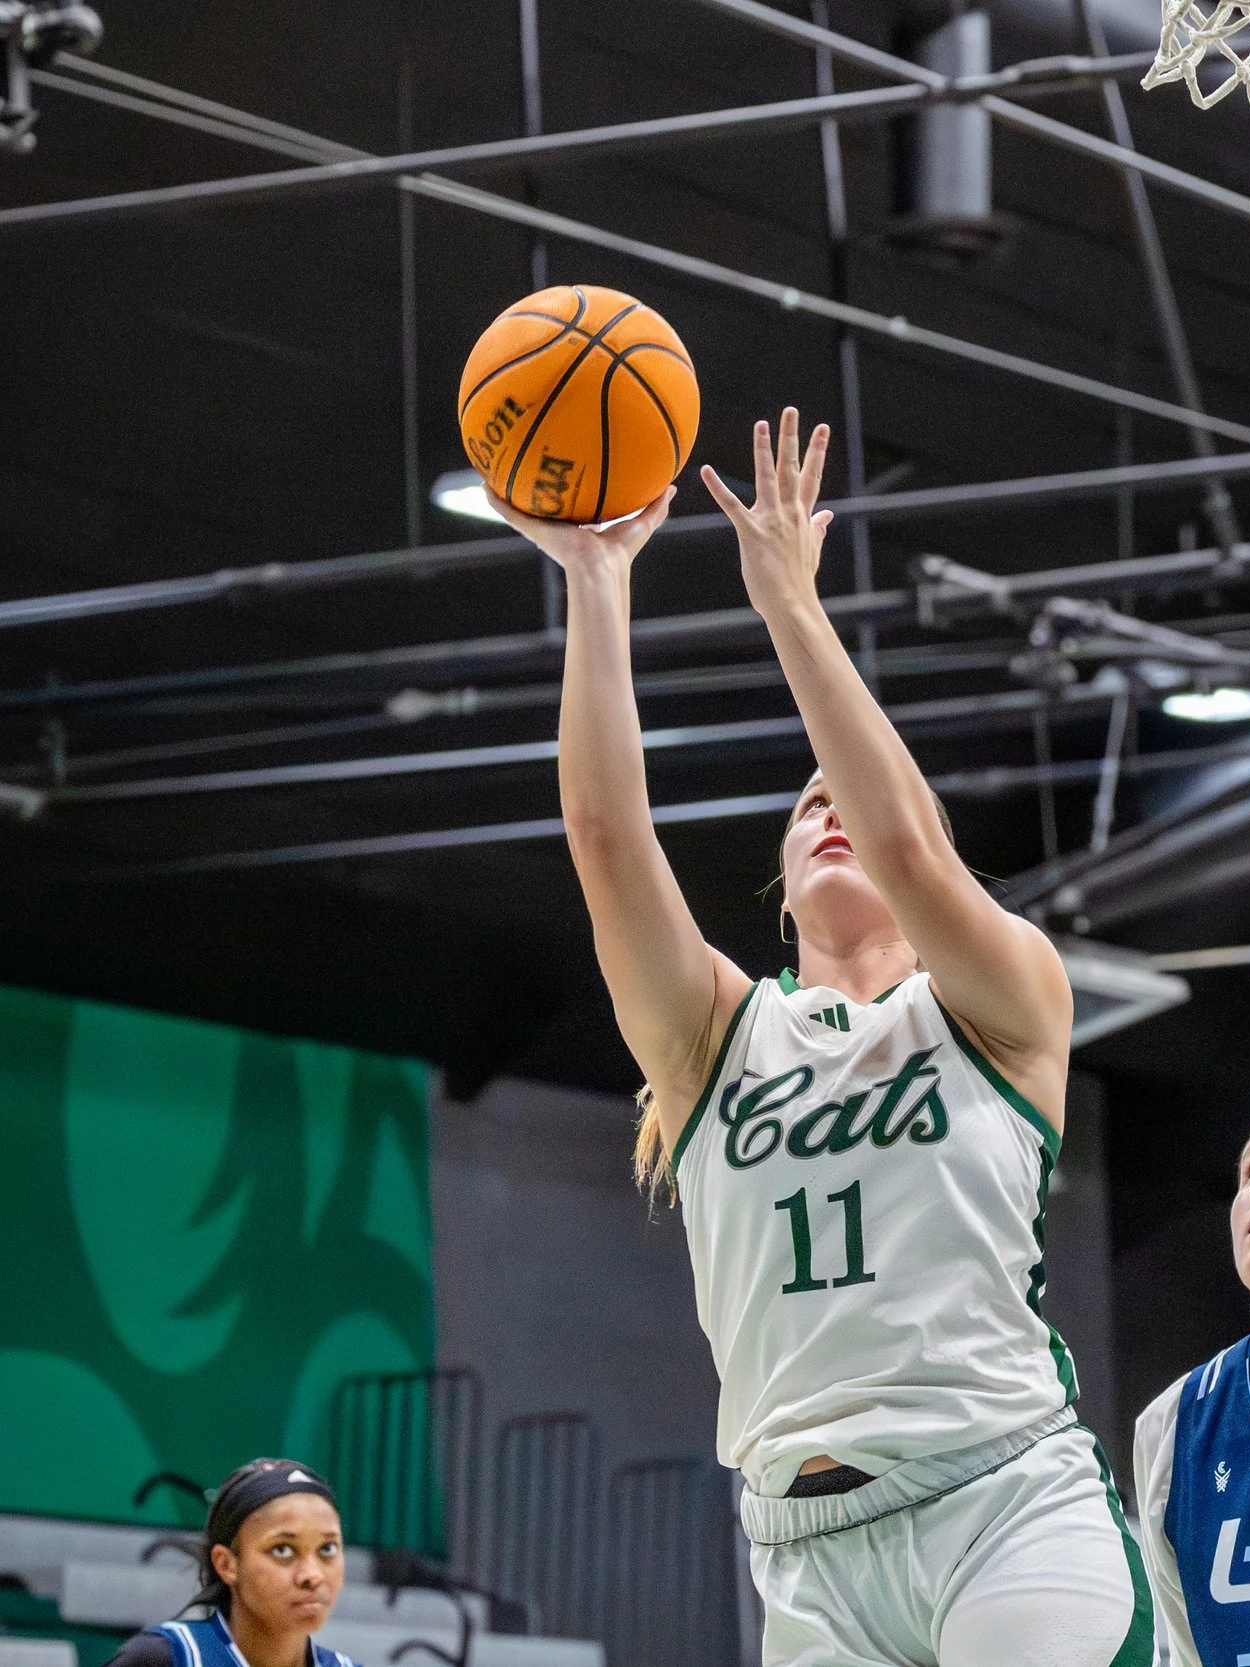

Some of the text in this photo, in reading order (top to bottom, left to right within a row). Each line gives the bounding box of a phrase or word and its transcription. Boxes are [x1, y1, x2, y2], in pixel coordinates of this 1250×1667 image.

[468, 396, 527, 471] lson
[719, 1042, 951, 1170] Cats
[774, 1179, 876, 1294] 11
